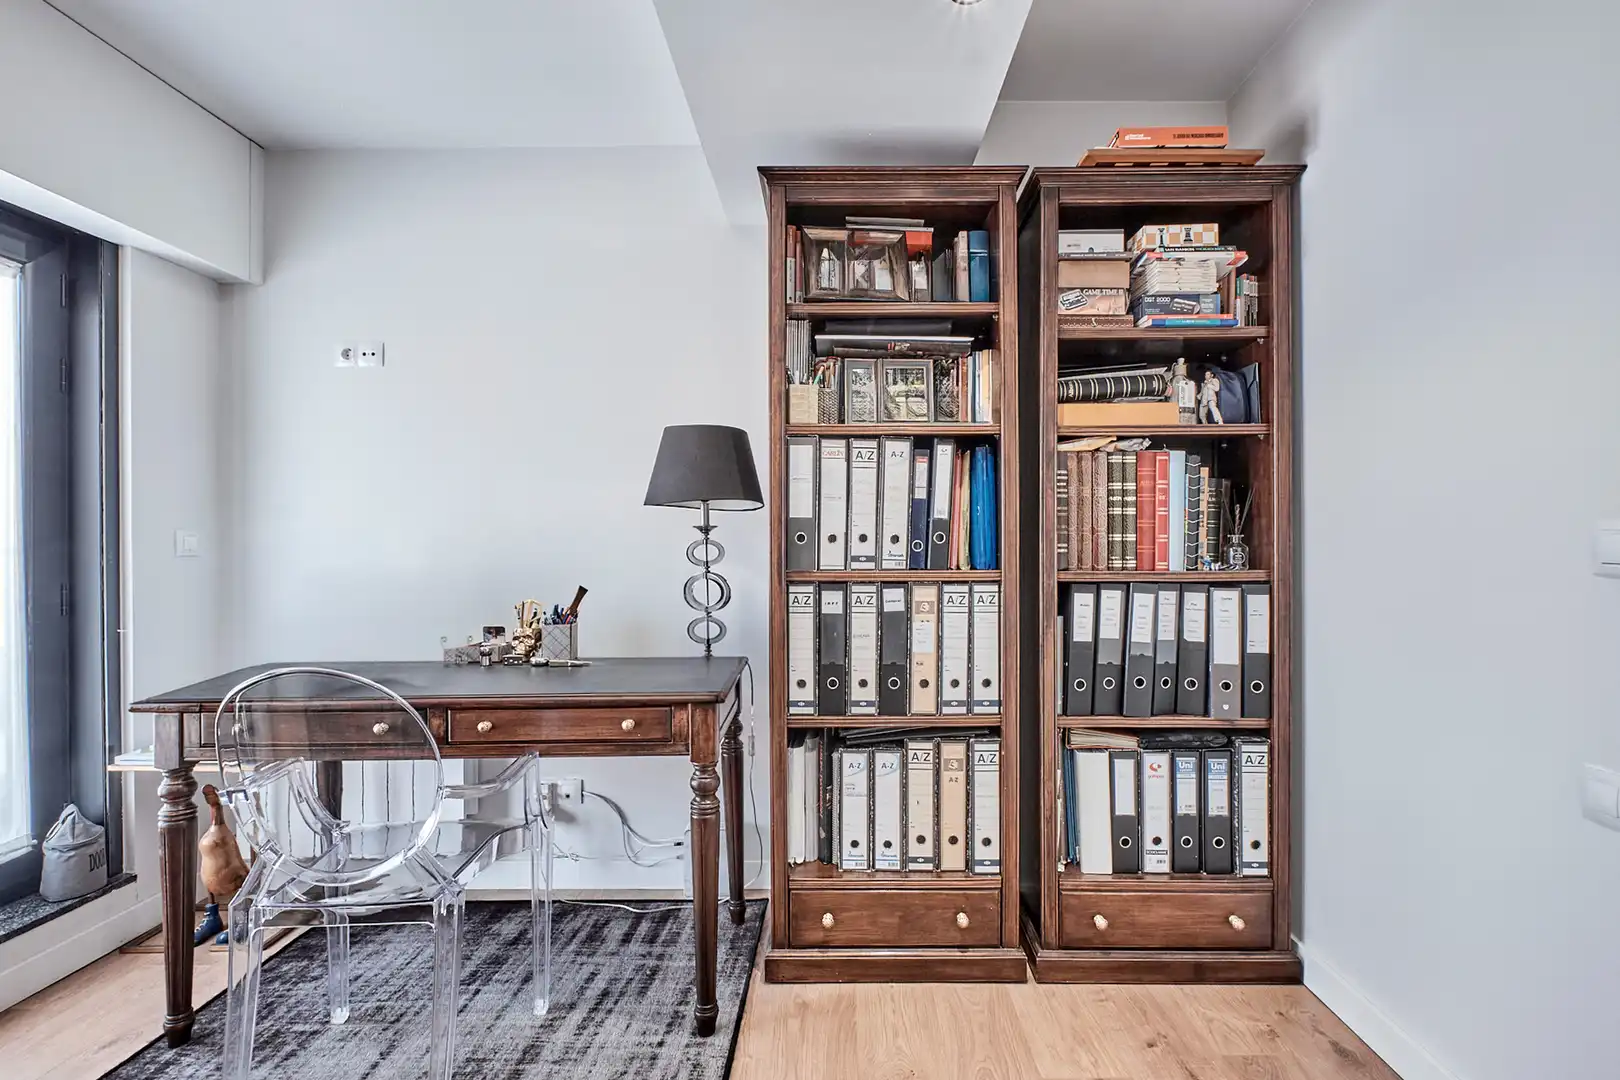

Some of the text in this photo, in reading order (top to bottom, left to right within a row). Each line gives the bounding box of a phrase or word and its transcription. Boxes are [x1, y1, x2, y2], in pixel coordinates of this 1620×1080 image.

[855, 450, 875, 461] A/Z
[791, 595, 811, 606] A/Z
[854, 595, 874, 606] A/Z
[946, 595, 966, 605] A/Z
[977, 594, 996, 605] A/Z
[911, 752, 931, 763] A/Z
[977, 753, 996, 764] A/Z
[1244, 754, 1265, 765] A/Z
[1179, 761, 1193, 769] Uni
[1211, 762, 1225, 770] Uni
